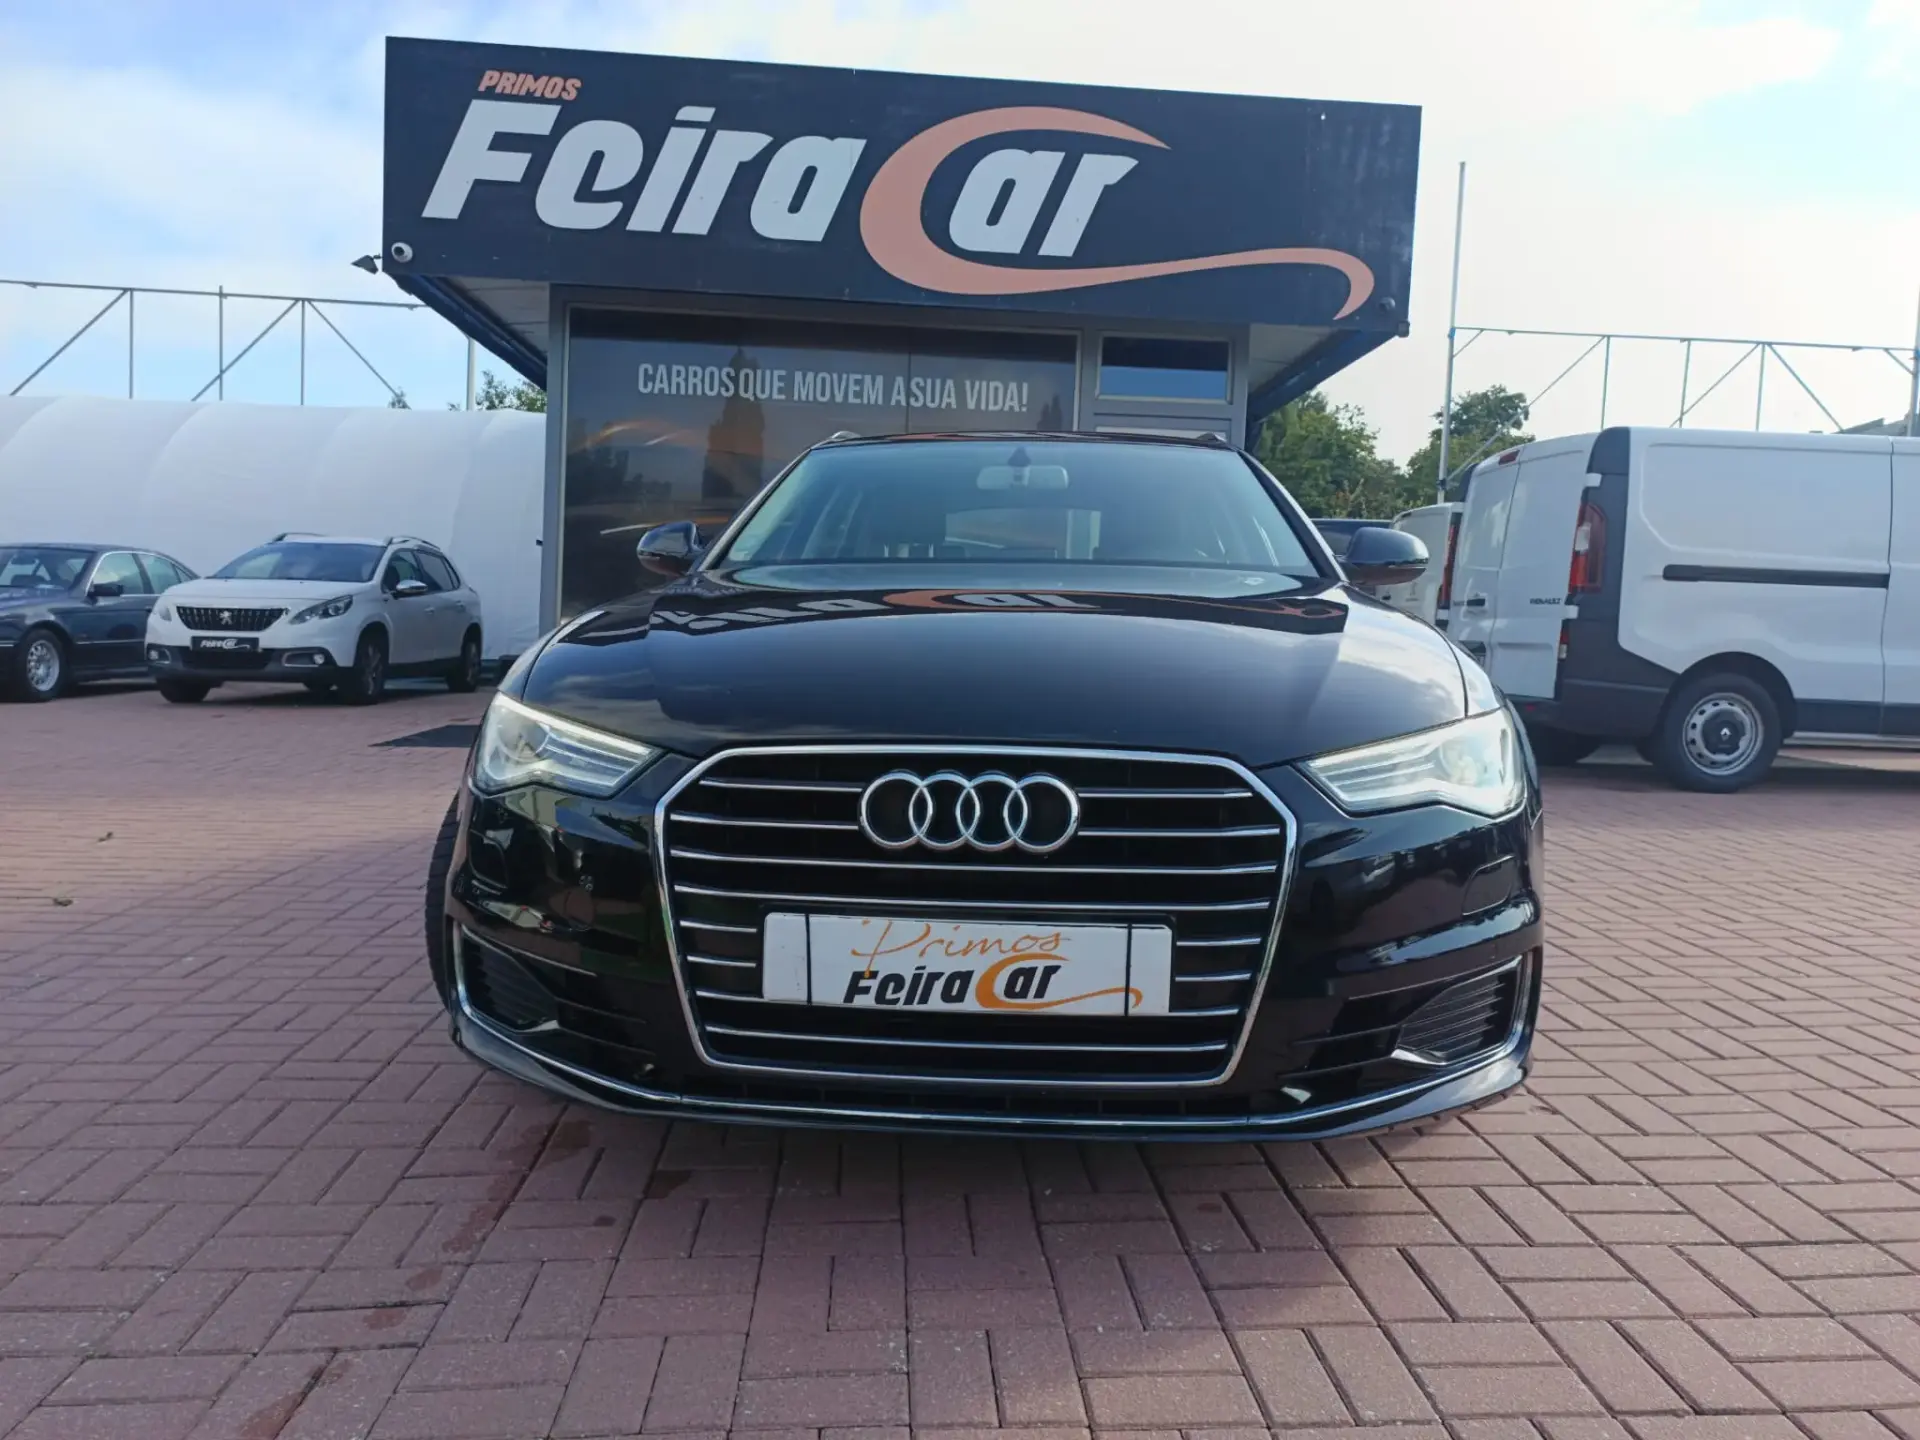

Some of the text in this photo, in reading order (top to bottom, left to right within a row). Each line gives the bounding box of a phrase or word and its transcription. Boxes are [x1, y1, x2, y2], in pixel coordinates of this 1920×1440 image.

[478, 69, 582, 101] PRIMOS
[638, 363, 1029, 412] CARROS QUE MOVEM A SUA VIDA!
[851, 918, 1072, 978] Primos
